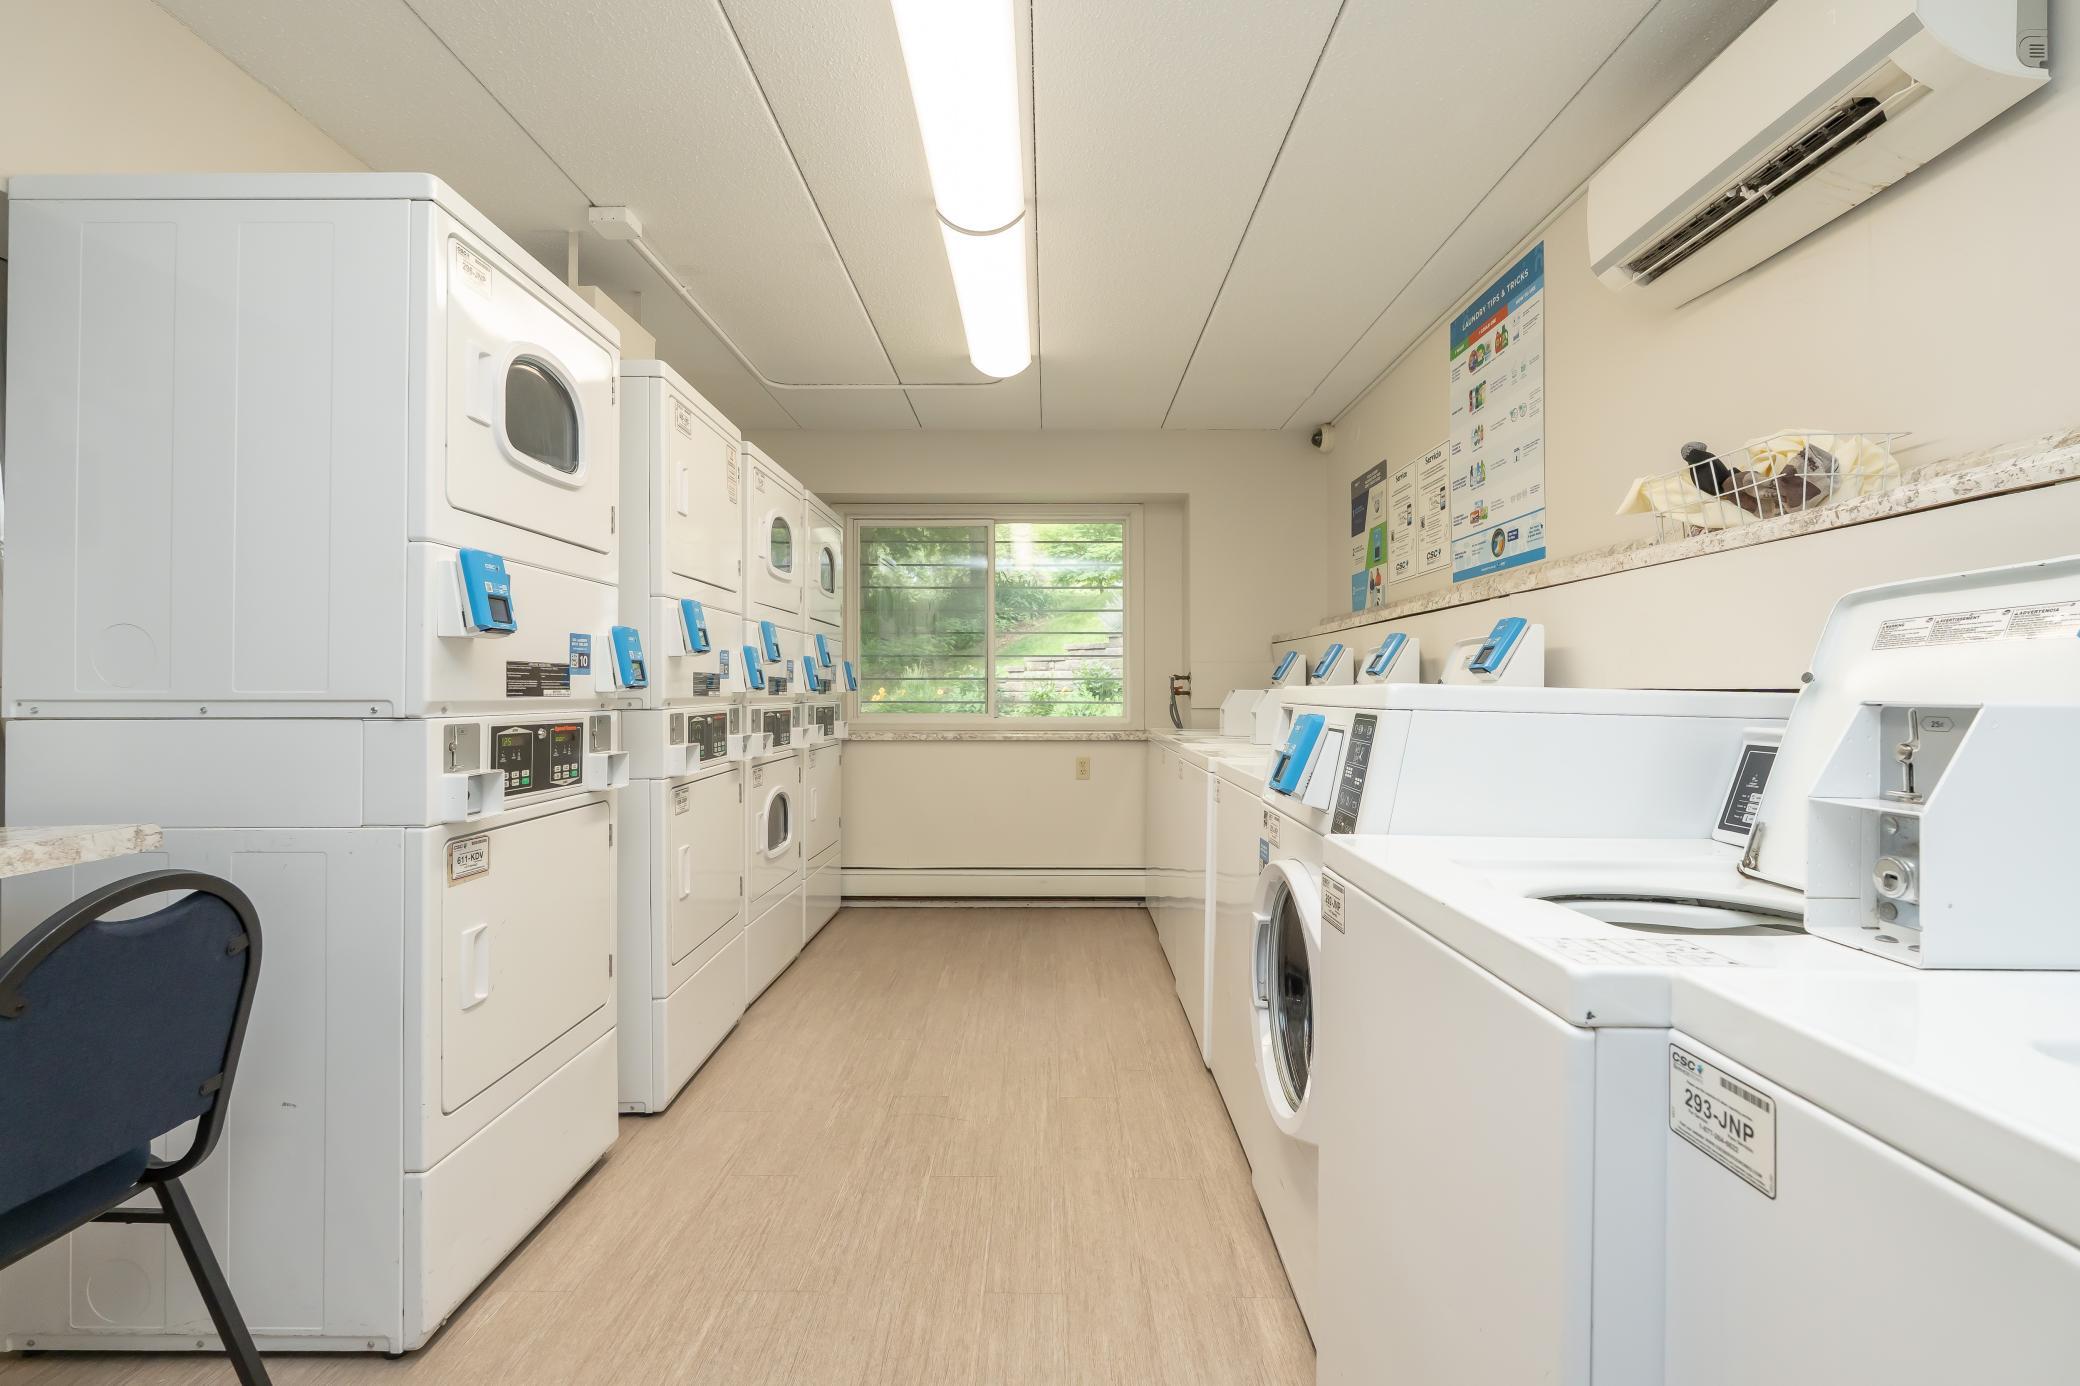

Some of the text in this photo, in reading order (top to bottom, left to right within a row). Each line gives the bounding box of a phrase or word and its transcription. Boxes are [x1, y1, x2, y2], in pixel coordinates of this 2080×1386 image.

[1462, 304, 1487, 332] LAUNDRY
[1487, 293, 1500, 312] TIPS
[1500, 288, 1506, 298] &
[1506, 268, 1530, 293] TRICKS
[1424, 450, 1442, 465] Servicio
[1395, 471, 1408, 483] Service
[1426, 549, 1438, 560] CSC
[1396, 560, 1406, 571] CSC
[579, 655, 588, 667] 10
[456, 850, 484, 865] 611-KDV
[1672, 1051, 1696, 1071] CSC
[1684, 1088, 1754, 1142] 293-JNP
